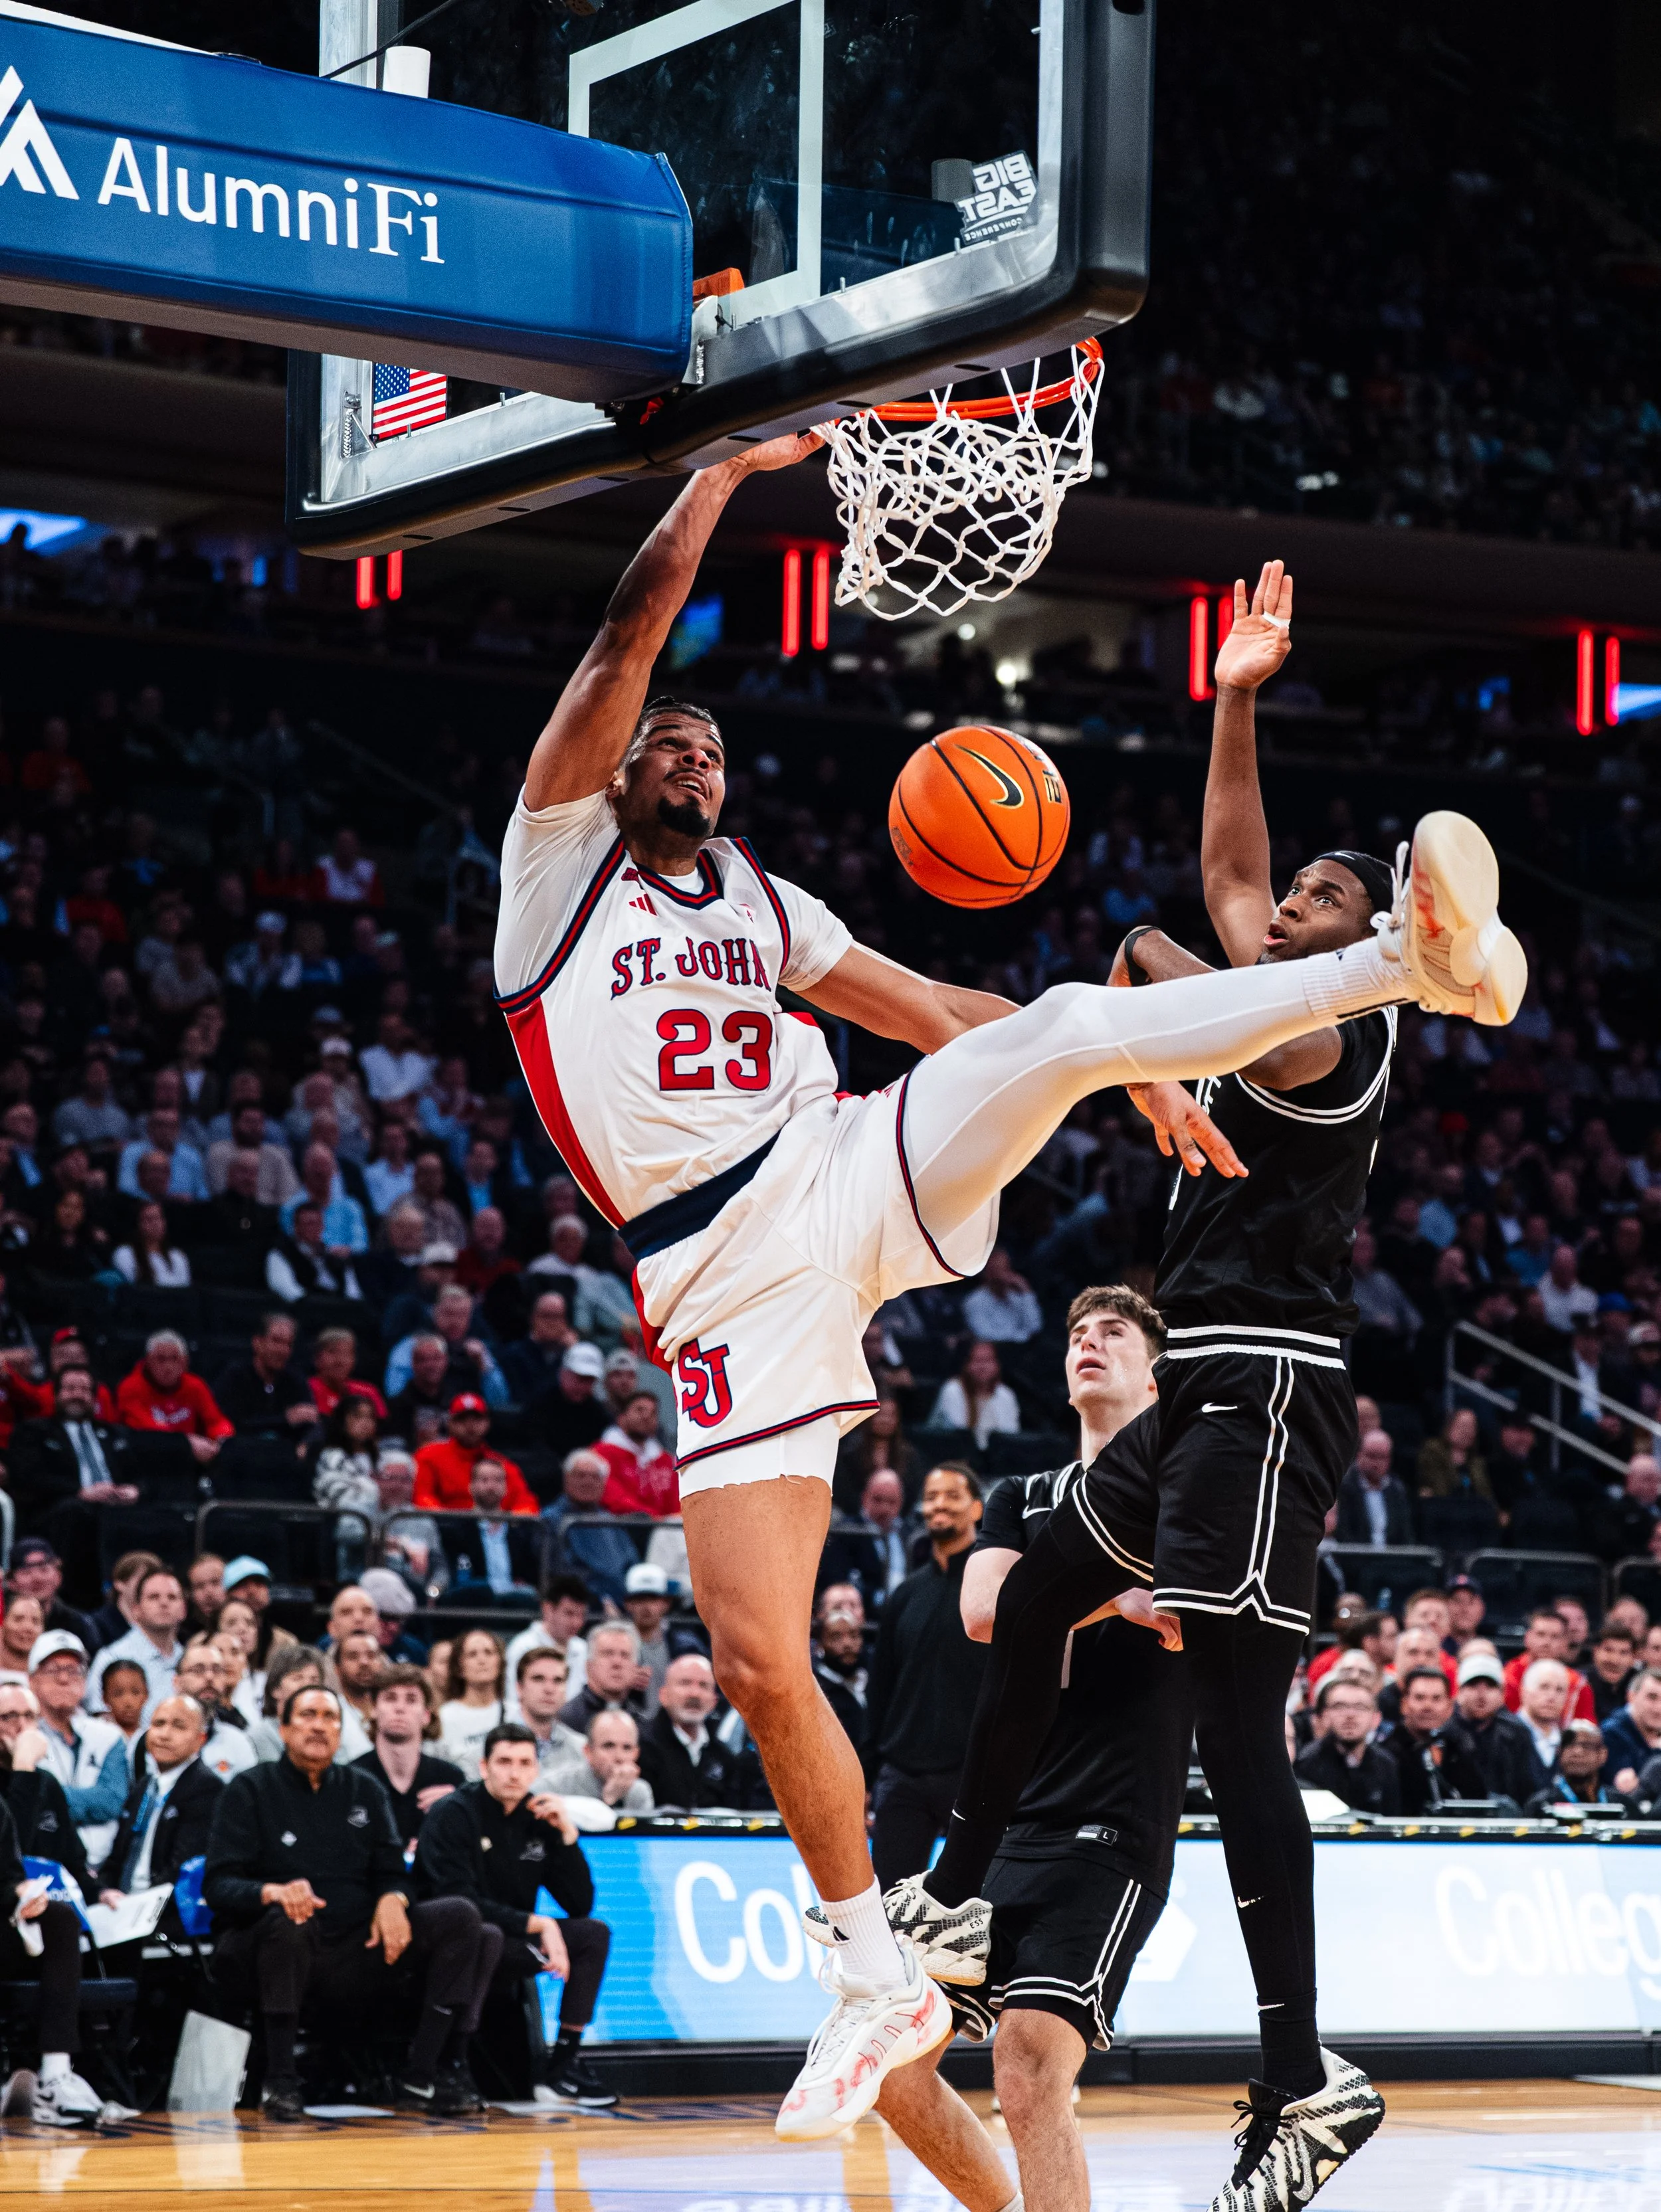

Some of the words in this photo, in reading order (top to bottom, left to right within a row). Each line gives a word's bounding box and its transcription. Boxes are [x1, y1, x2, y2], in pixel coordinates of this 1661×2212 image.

[97, 137, 445, 264] AlumniFi
[611, 937, 666, 1000] ST.
[656, 1008, 772, 1091] 23
[1102, 1831, 1108, 1839] L
[674, 1860, 836, 1983] Col
[969, 1918, 984, 1929] ESS
